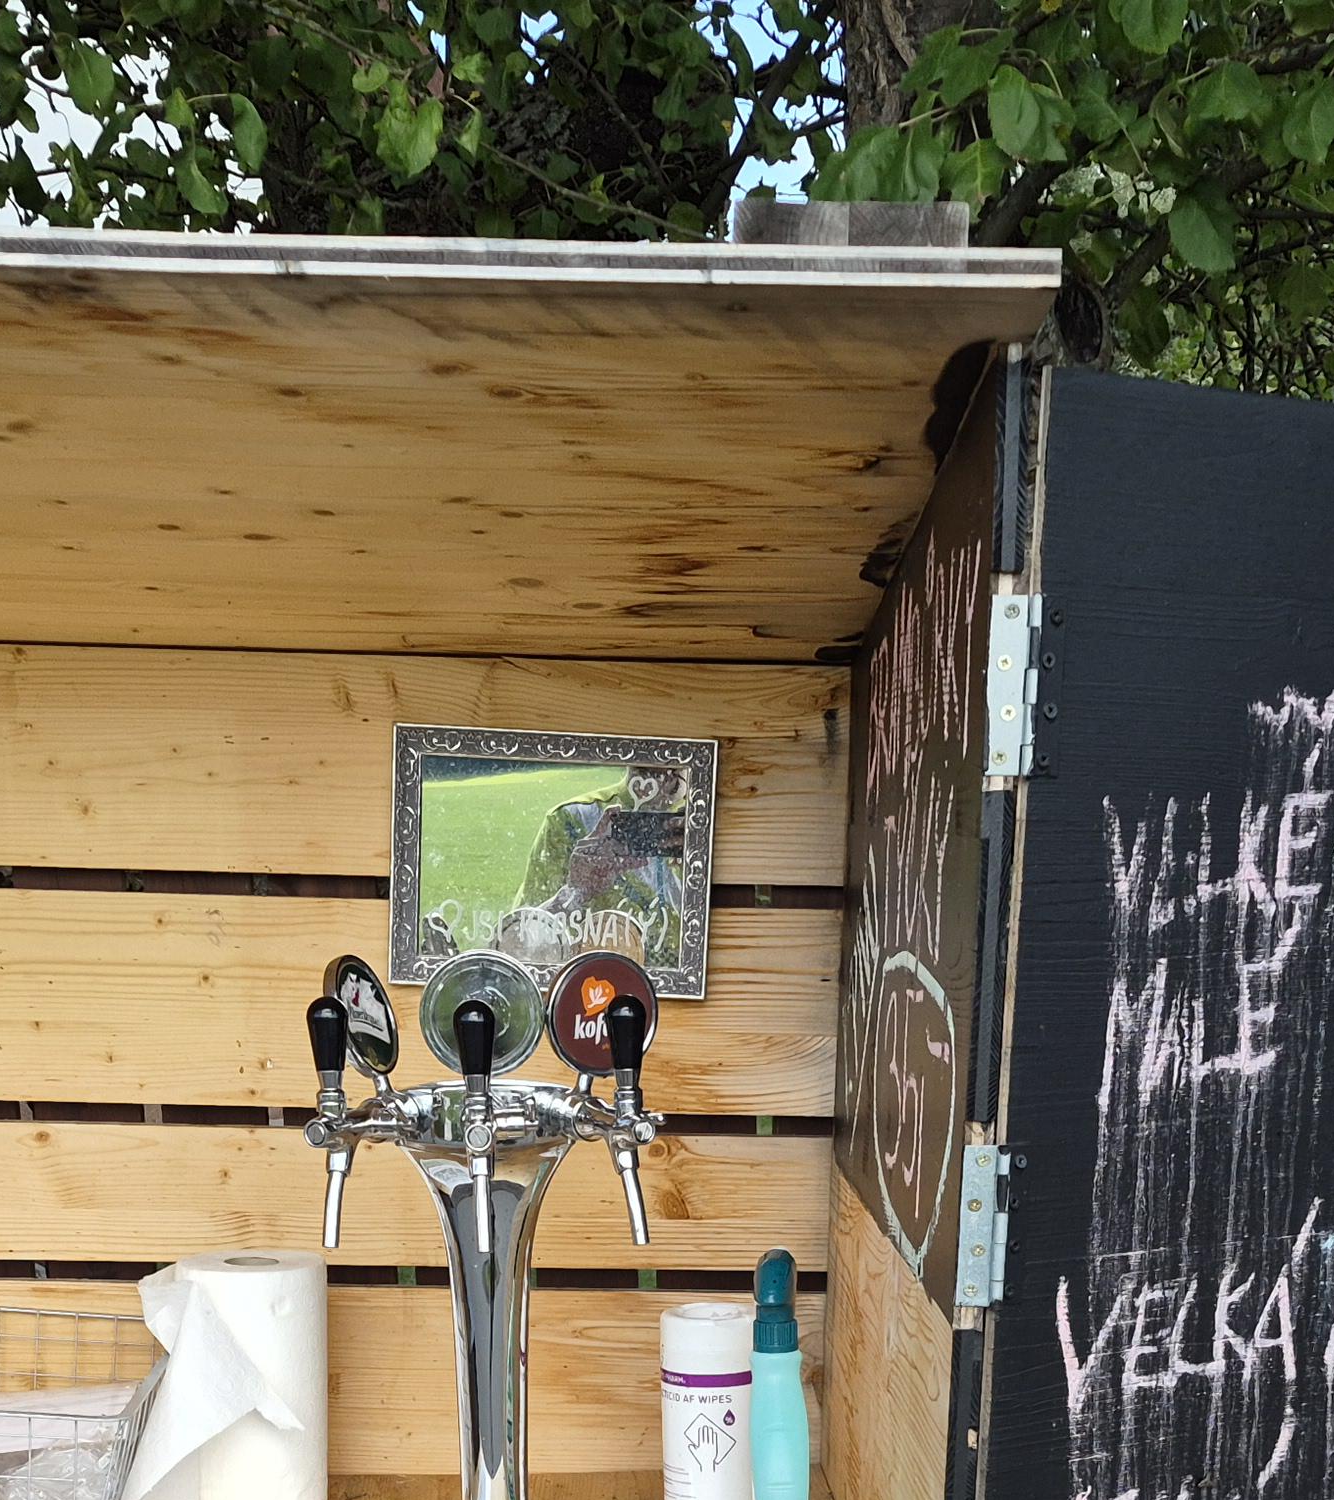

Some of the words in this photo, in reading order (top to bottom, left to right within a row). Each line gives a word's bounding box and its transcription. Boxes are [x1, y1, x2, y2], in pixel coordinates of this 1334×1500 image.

[574, 1012, 609, 1046] kof
[683, 1394, 695, 1403] AF
[698, 1394, 733, 1404] WIPES
